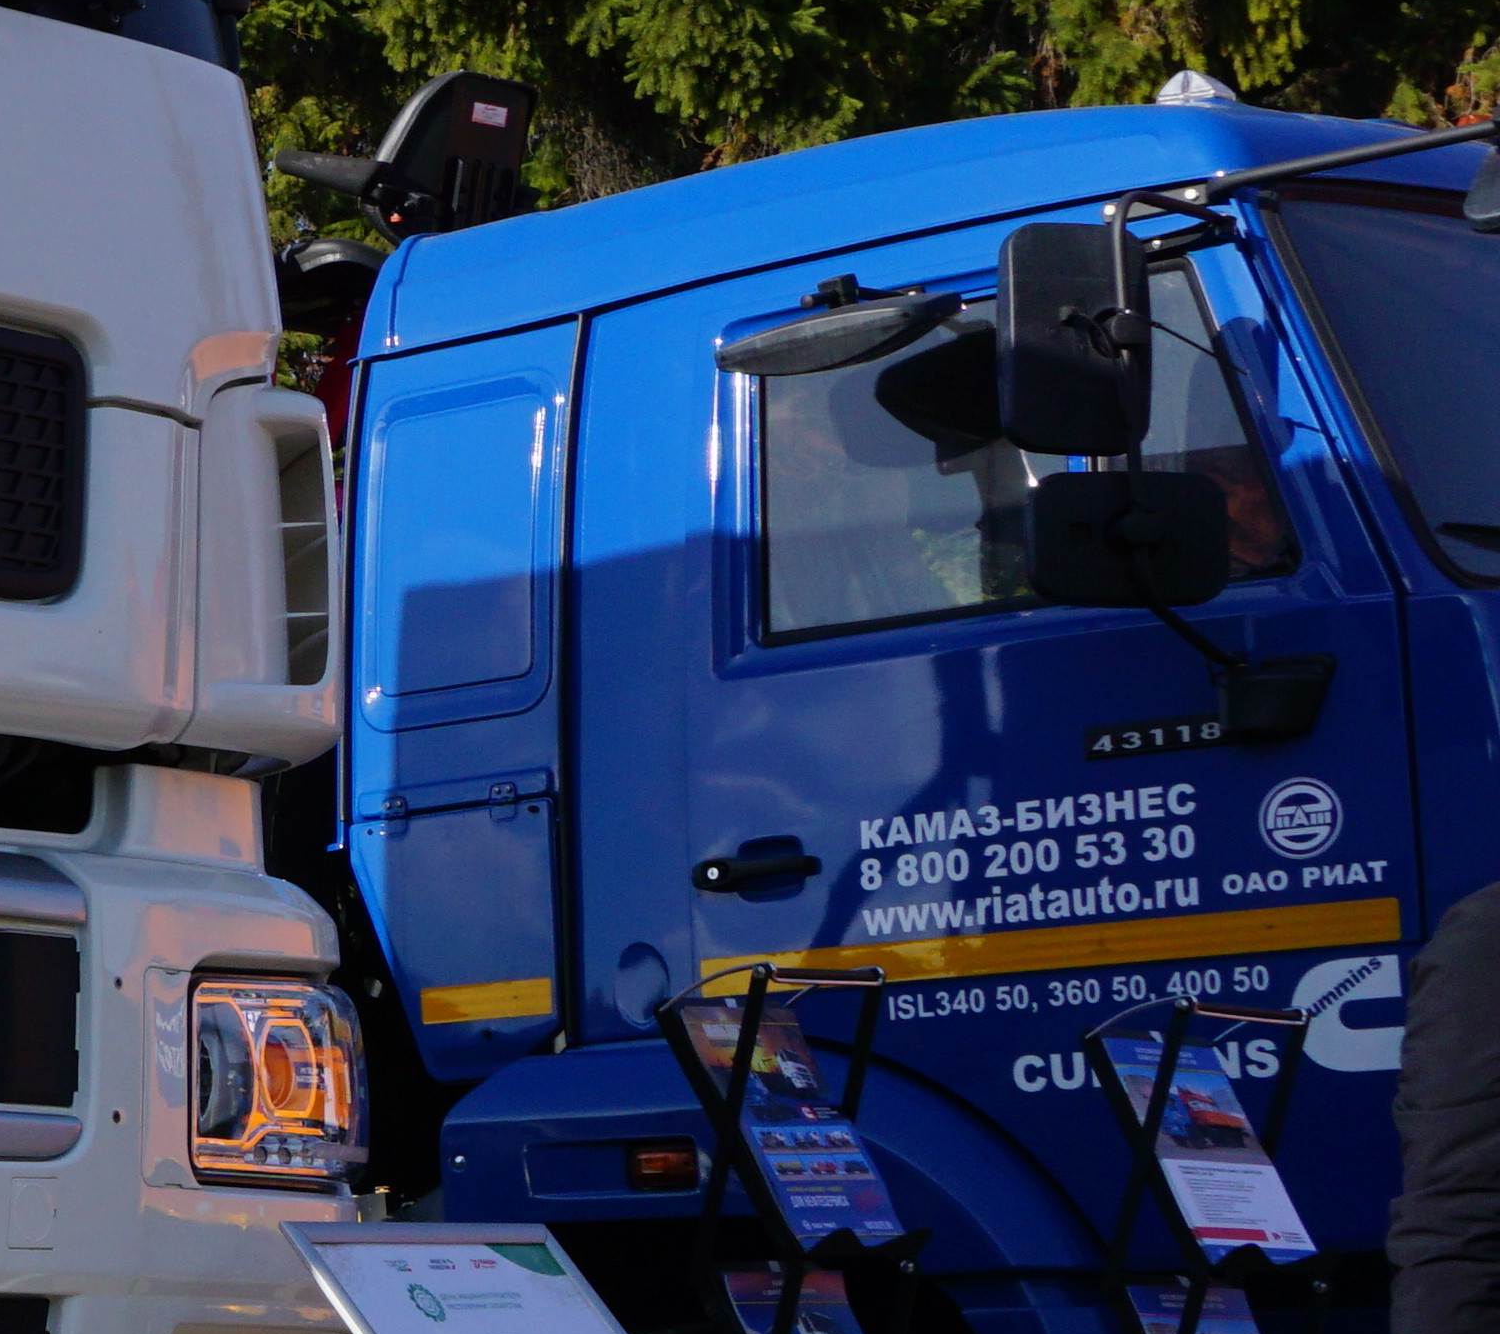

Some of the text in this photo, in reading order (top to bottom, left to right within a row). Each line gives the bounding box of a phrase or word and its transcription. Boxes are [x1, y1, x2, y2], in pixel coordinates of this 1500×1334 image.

[1091, 721, 1222, 753] 43118
[859, 783, 1197, 850] КАМАЗ-БИЗНЕС
[860, 824, 1196, 891] 8 800 200 53 30
[1222, 860, 1389, 896] ОАО РИАТ
[862, 875, 1200, 937] www.riatauto.ru
[887, 988, 986, 1021] ISL340
[995, 984, 1039, 1013] 50,
[1047, 978, 1101, 1008] 360
[1167, 968, 1222, 997] 400
[1232, 965, 1270, 993] 50
[1012, 1038, 1282, 1093] CUNS
